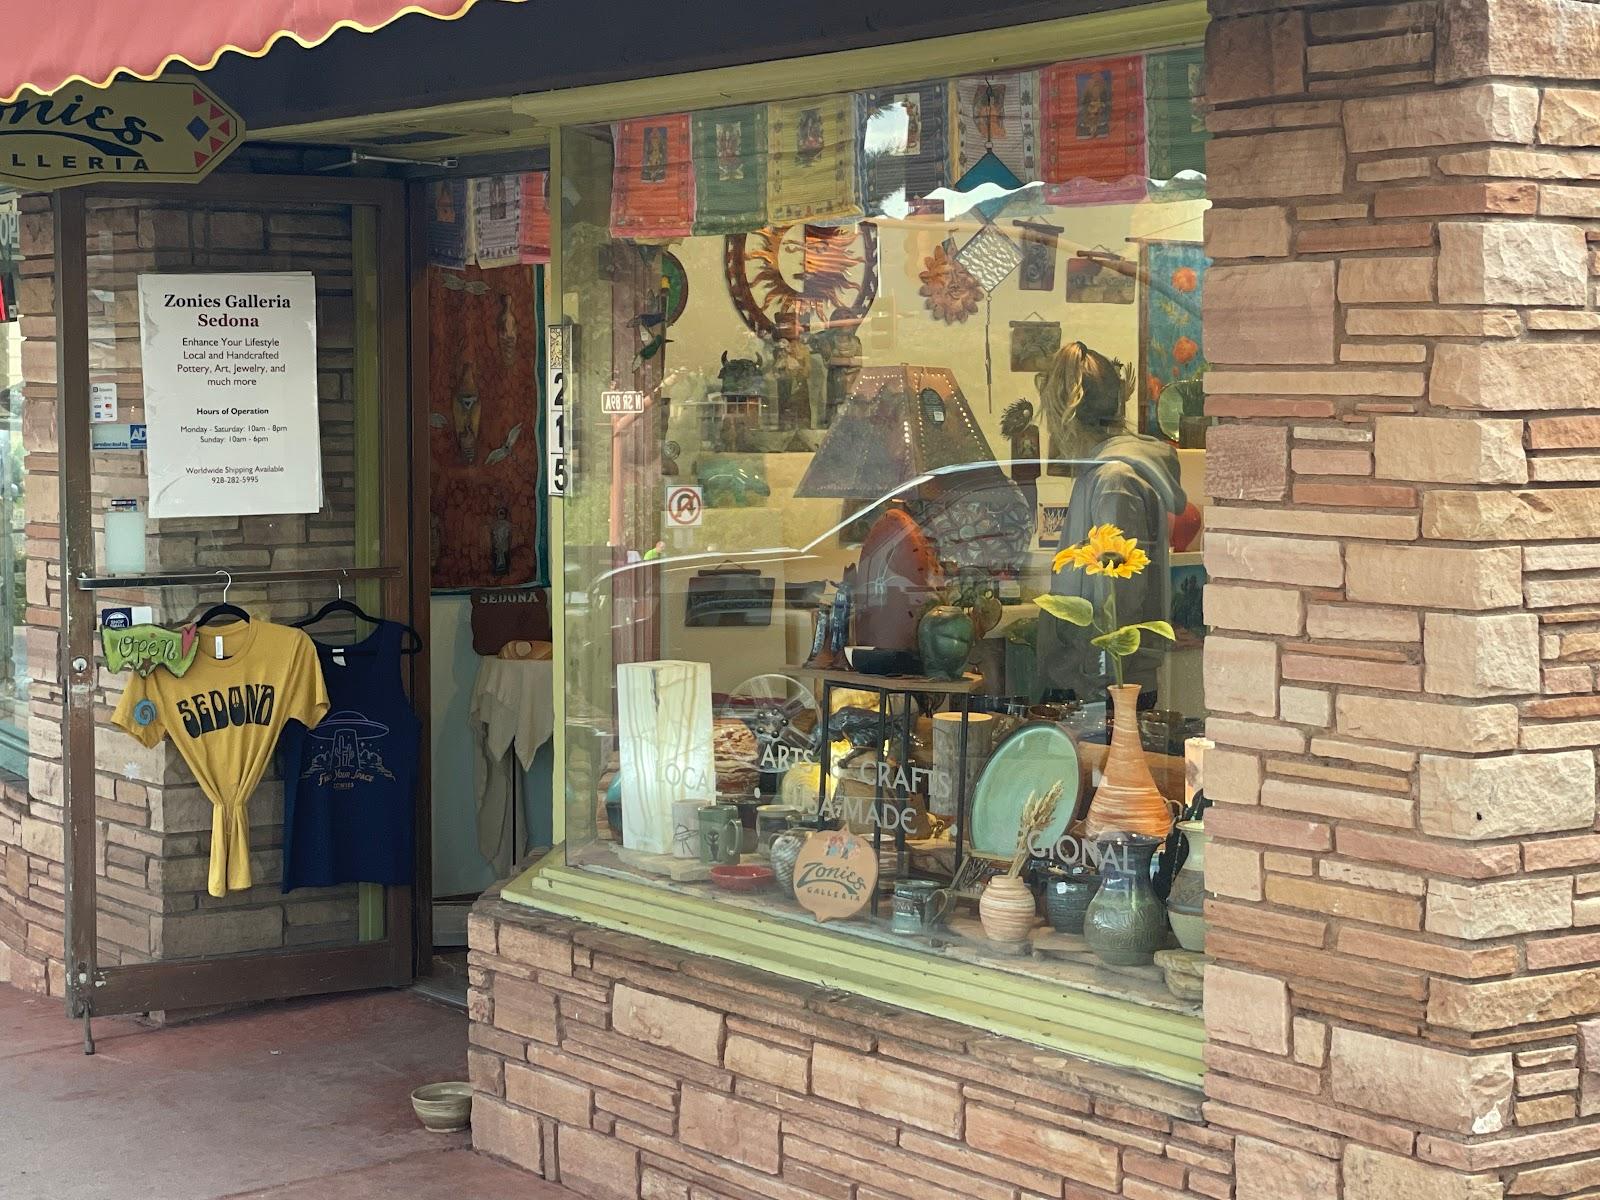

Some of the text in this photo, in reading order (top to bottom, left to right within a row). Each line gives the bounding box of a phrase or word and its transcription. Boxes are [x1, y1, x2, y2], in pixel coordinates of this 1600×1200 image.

[12, 153, 150, 171] LLERIA
[164, 294, 291, 308] Zonies Galleria
[198, 313, 259, 327] Sedona
[182, 337, 280, 349] Enhance Your Lifestyle
[183, 351, 279, 360] Local and Handcrafted
[177, 363, 286, 375] Pottery, Art, Jewelry, and
[207, 377, 257, 386] much more
[196, 407, 269, 416] Hours of Operation
[180, 426, 208, 434] Monday
[272, 424, 288, 433] 8pm
[228, 435, 247, 443] 10am
[253, 435, 269, 444] 6pm
[185, 465, 285, 476] Worldwide Shipping Available
[211, 476, 259, 484] 928-282-5995
[480, 591, 539, 604] SEDONA
[118, 635, 176, 663] Open
[176, 684, 275, 739] SEDONA
[760, 743, 815, 772] ARTS
[860, 760, 951, 798] CRAFTS
